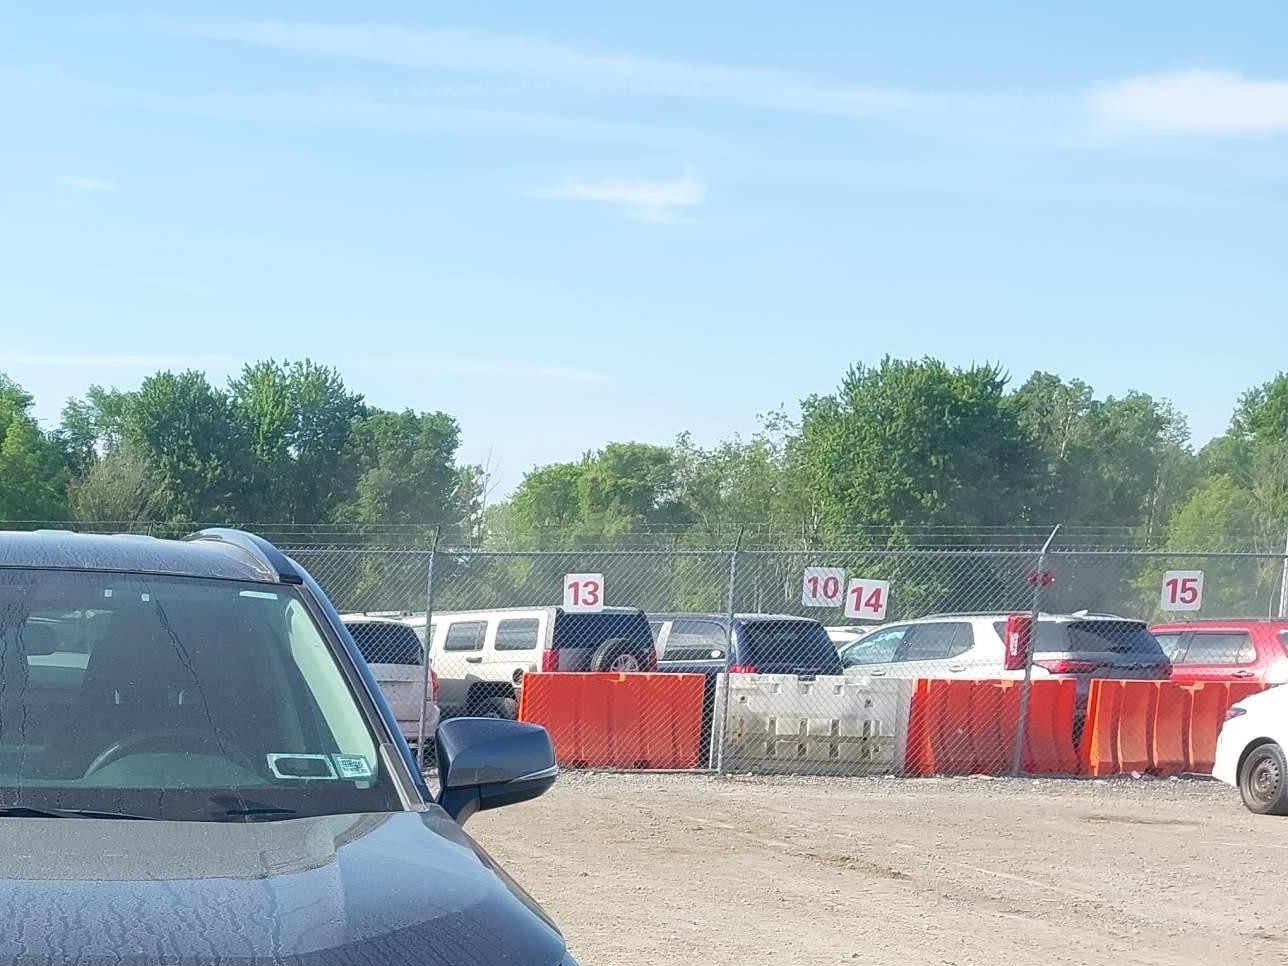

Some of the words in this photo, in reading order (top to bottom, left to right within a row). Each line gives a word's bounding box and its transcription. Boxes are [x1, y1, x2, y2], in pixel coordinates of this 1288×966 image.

[567, 580, 600, 606] 13
[807, 575, 839, 599] 10
[850, 586, 883, 613] 14
[1165, 578, 1199, 605] 15
